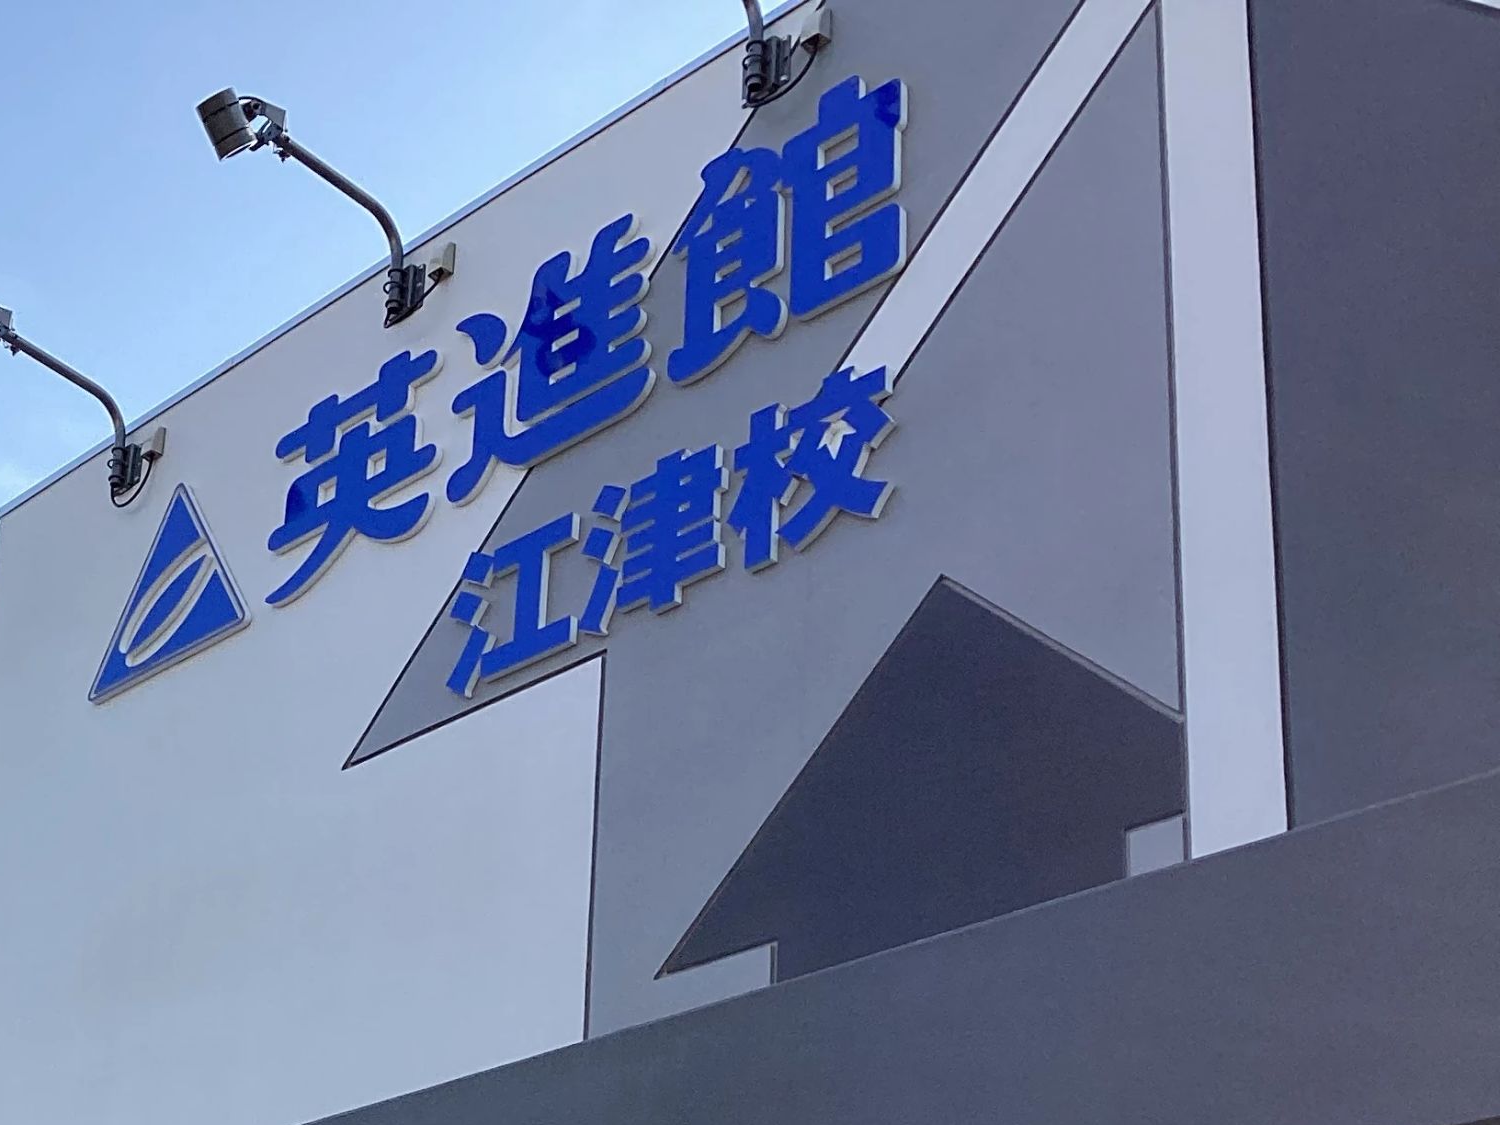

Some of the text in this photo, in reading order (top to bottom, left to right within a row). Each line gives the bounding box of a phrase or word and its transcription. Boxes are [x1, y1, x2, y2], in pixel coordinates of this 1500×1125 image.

[265, 75, 907, 606] 英進館
[445, 365, 895, 697] 江津校
